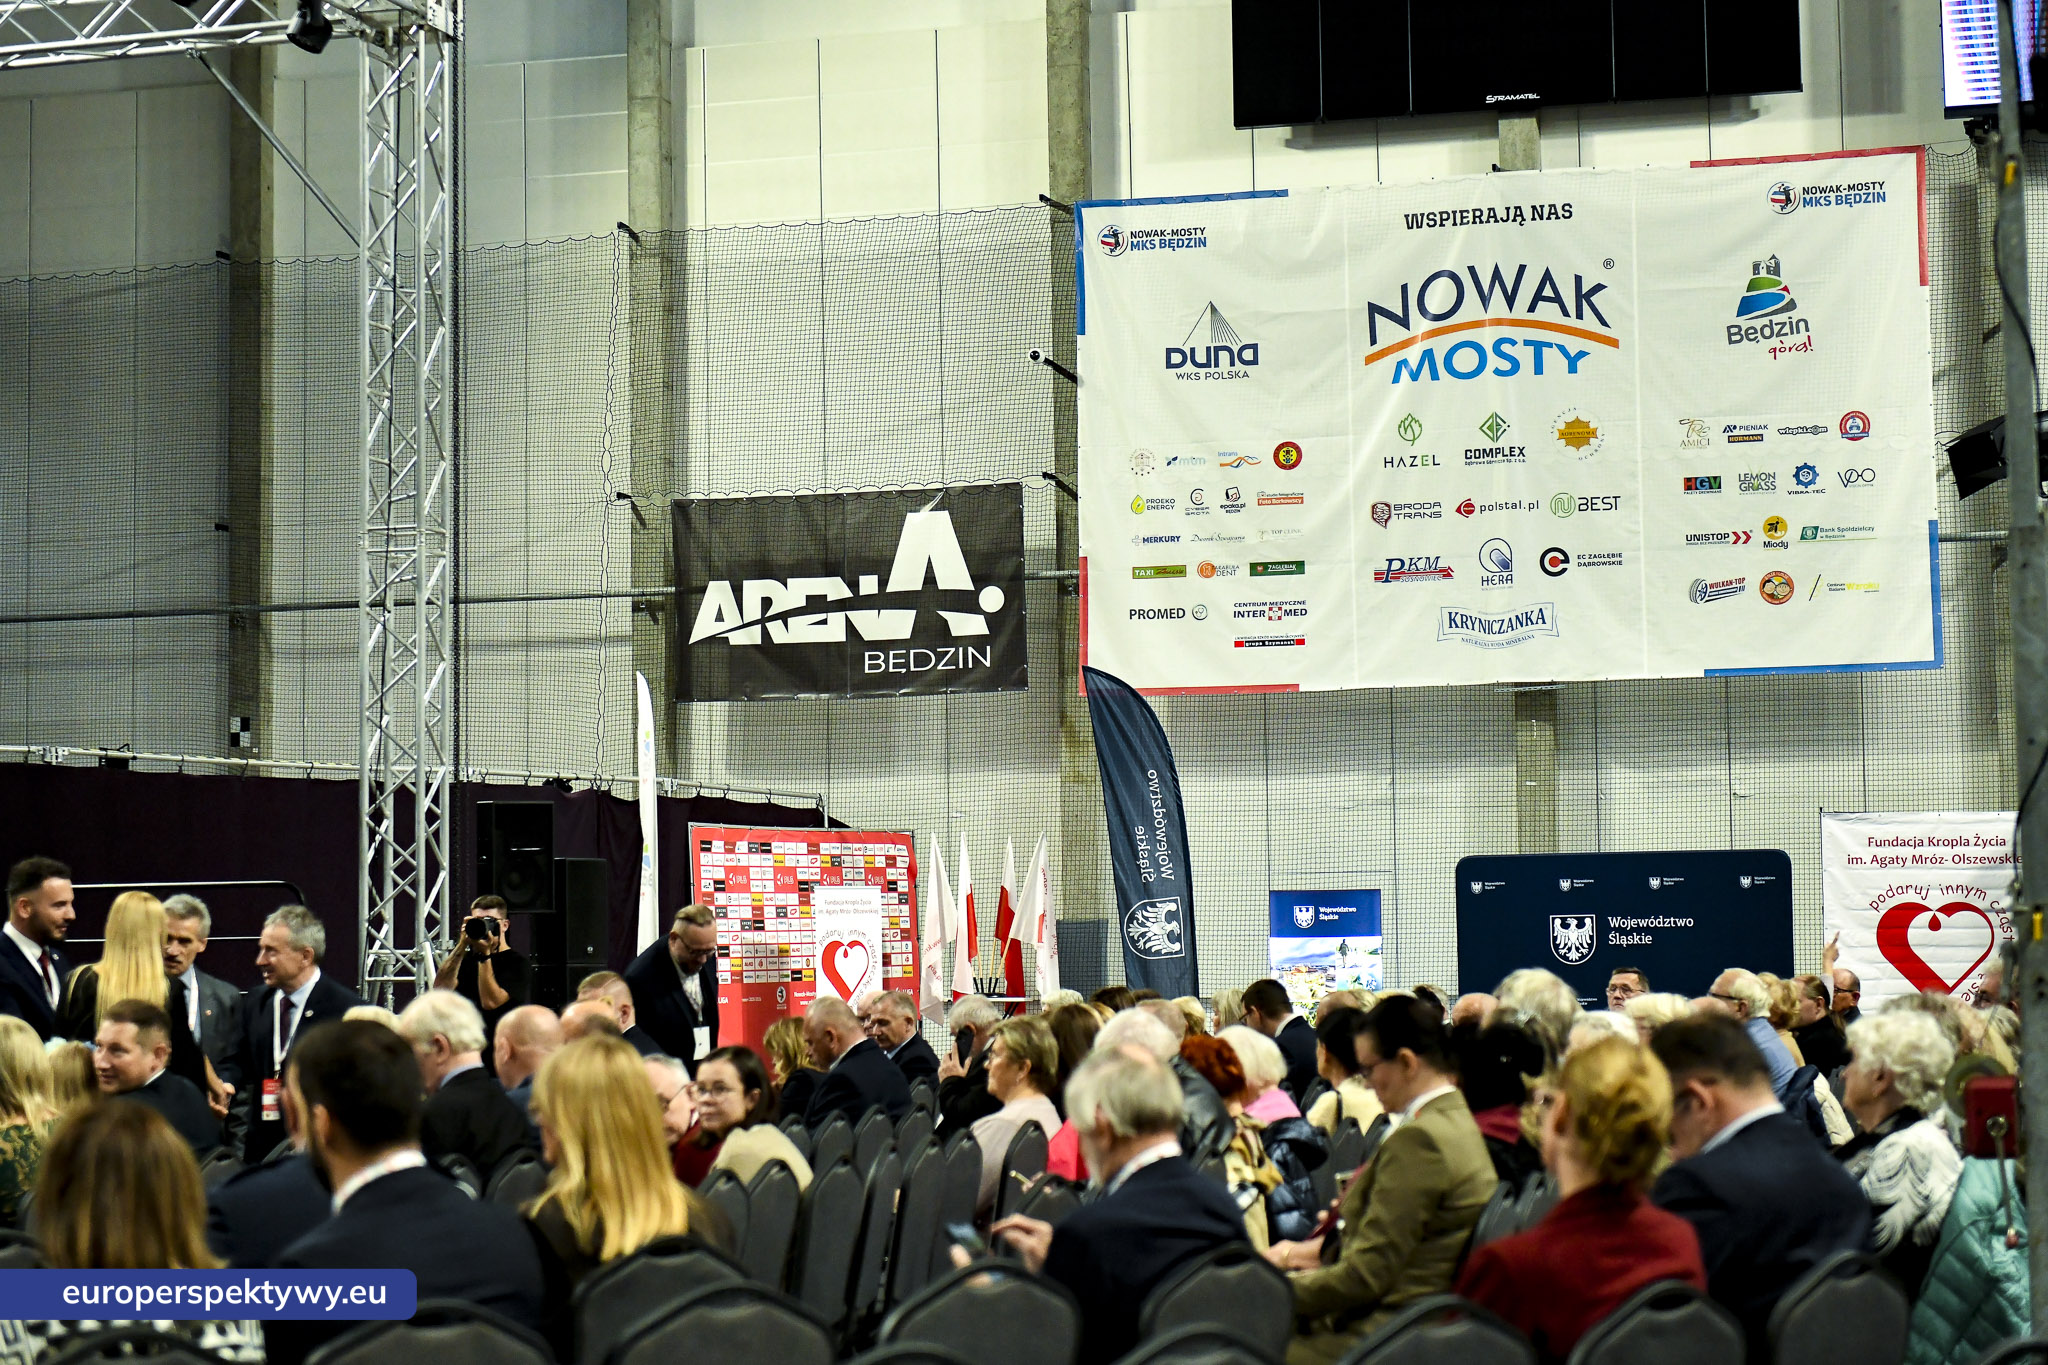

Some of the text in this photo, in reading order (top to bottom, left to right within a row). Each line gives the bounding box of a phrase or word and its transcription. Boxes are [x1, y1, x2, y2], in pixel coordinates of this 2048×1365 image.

[1486, 93, 1540, 103] STRAMATEL
[1802, 181, 1885, 196] NOWAK-MOSTY
[1802, 192, 1886, 208] MKS BĘDZIN
[1404, 203, 1573, 230] WSPIERAJĄ NAS
[1130, 227, 1206, 240] NOWAK-MOSTY
[1130, 236, 1207, 251] MKS BĘDZIN
[1367, 262, 1612, 347] NOWAK
[1727, 317, 1810, 345] Będzin
[1391, 337, 1591, 385] MOSTY
[1176, 370, 1250, 381] WKS POLSKA
[1464, 446, 1526, 460] COMPLEX
[1384, 454, 1441, 469] HAZEL
[1684, 476, 1721, 490] HGV
[1738, 472, 1776, 482] LEMON
[1394, 502, 1442, 511] BRODA
[1479, 500, 1539, 515] polstal.pl
[1578, 495, 1621, 512] BEST
[1394, 511, 1442, 520] TRANS
[1142, 535, 1181, 544] MERKURY
[1686, 533, 1730, 542] UNISTOP
[1763, 540, 1789, 550] Miody
[1588, 552, 1623, 560] ZAGŁĘBIE
[1382, 556, 1441, 583] PKM
[1481, 574, 1513, 586] HERA
[1709, 577, 1746, 590] WULKAN-TOP
[1129, 608, 1186, 620] PROMED
[1234, 608, 1308, 618] INTER MED
[1448, 607, 1547, 635] KRYNICZANKA
[865, 645, 991, 674] BĘDZIN
[1868, 833, 2006, 849] Fundacja Kropla Życia
[1847, 854, 1866, 865] im.
[1870, 854, 1908, 868] Agaty
[1869, 883, 1930, 913] podaruj
[1939, 883, 1987, 901] innym
[1608, 915, 1694, 930] Województwo
[819, 929, 844, 947] podaruj
[1608, 931, 1652, 947] Śląskie
